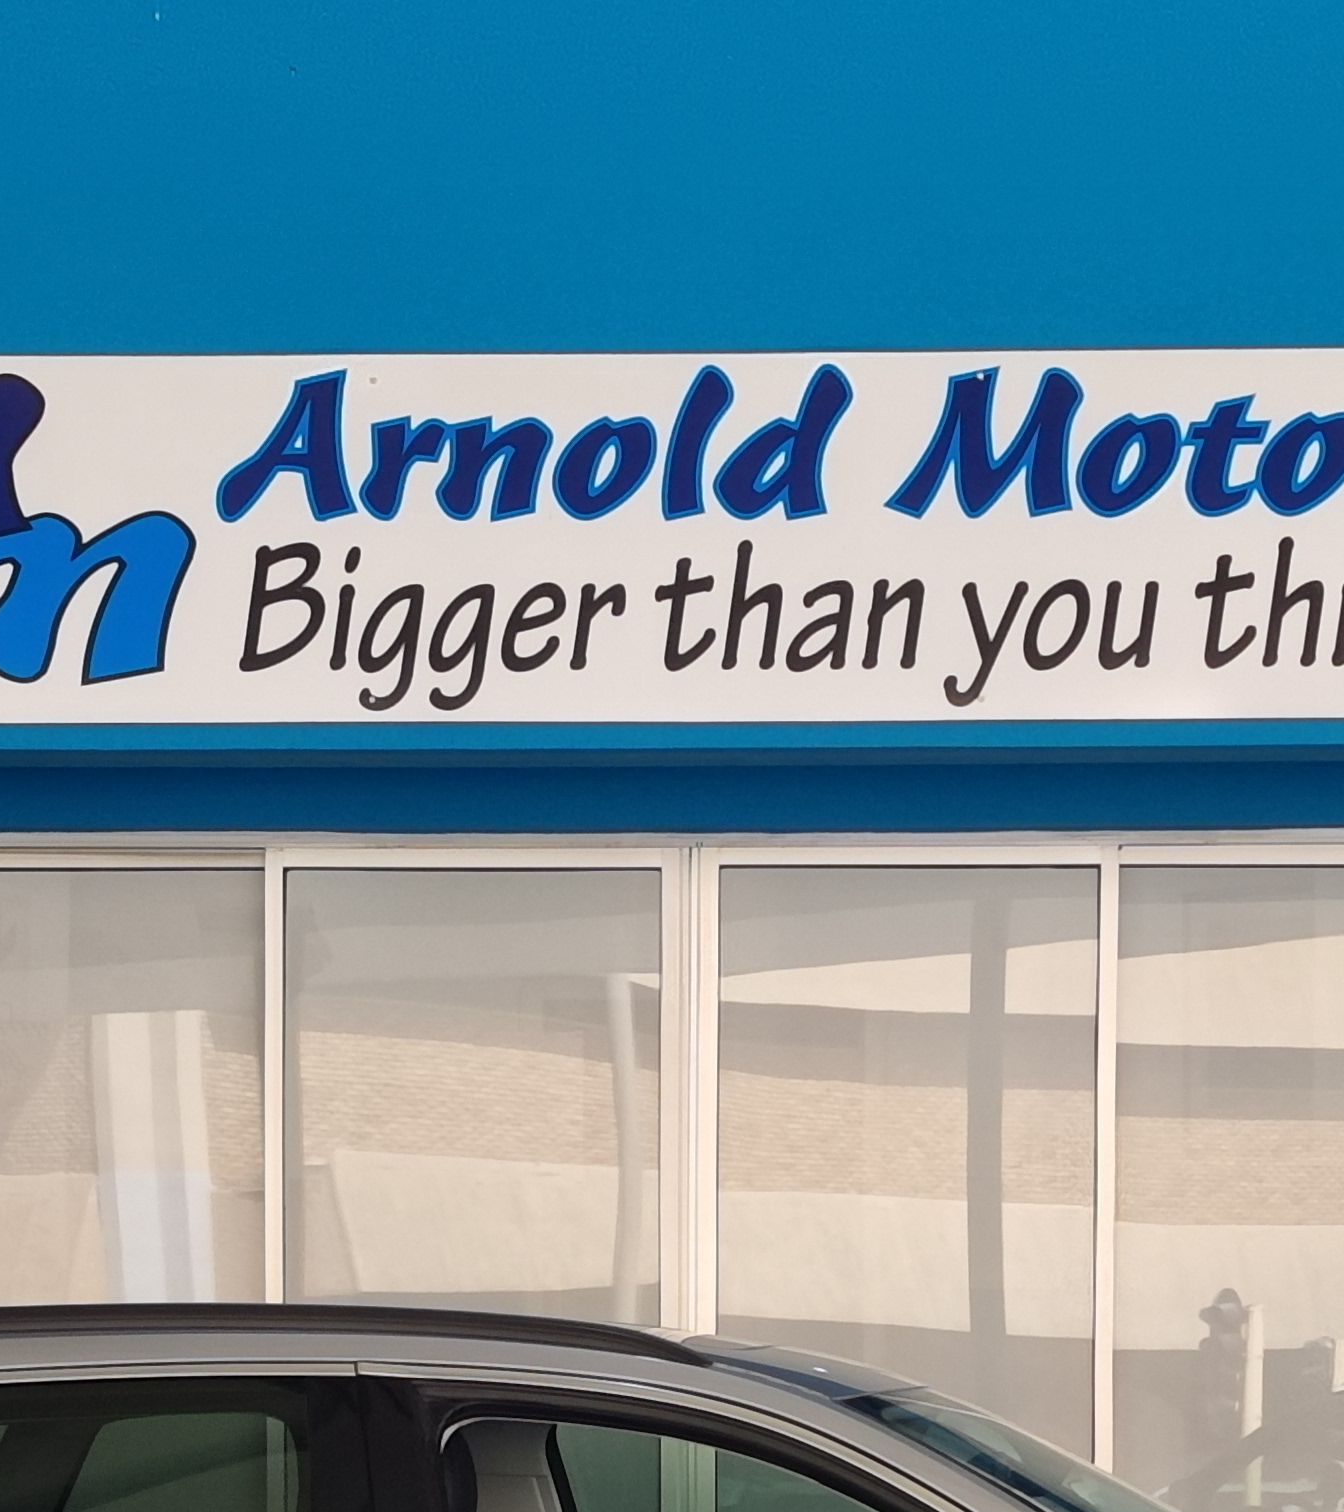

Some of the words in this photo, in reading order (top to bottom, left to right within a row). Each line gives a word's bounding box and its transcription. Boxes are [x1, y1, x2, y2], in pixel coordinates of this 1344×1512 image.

[216, 363, 853, 521] Arnold
[239, 542, 626, 711] Bigger
[655, 539, 925, 672] than
[944, 578, 1159, 707] you
